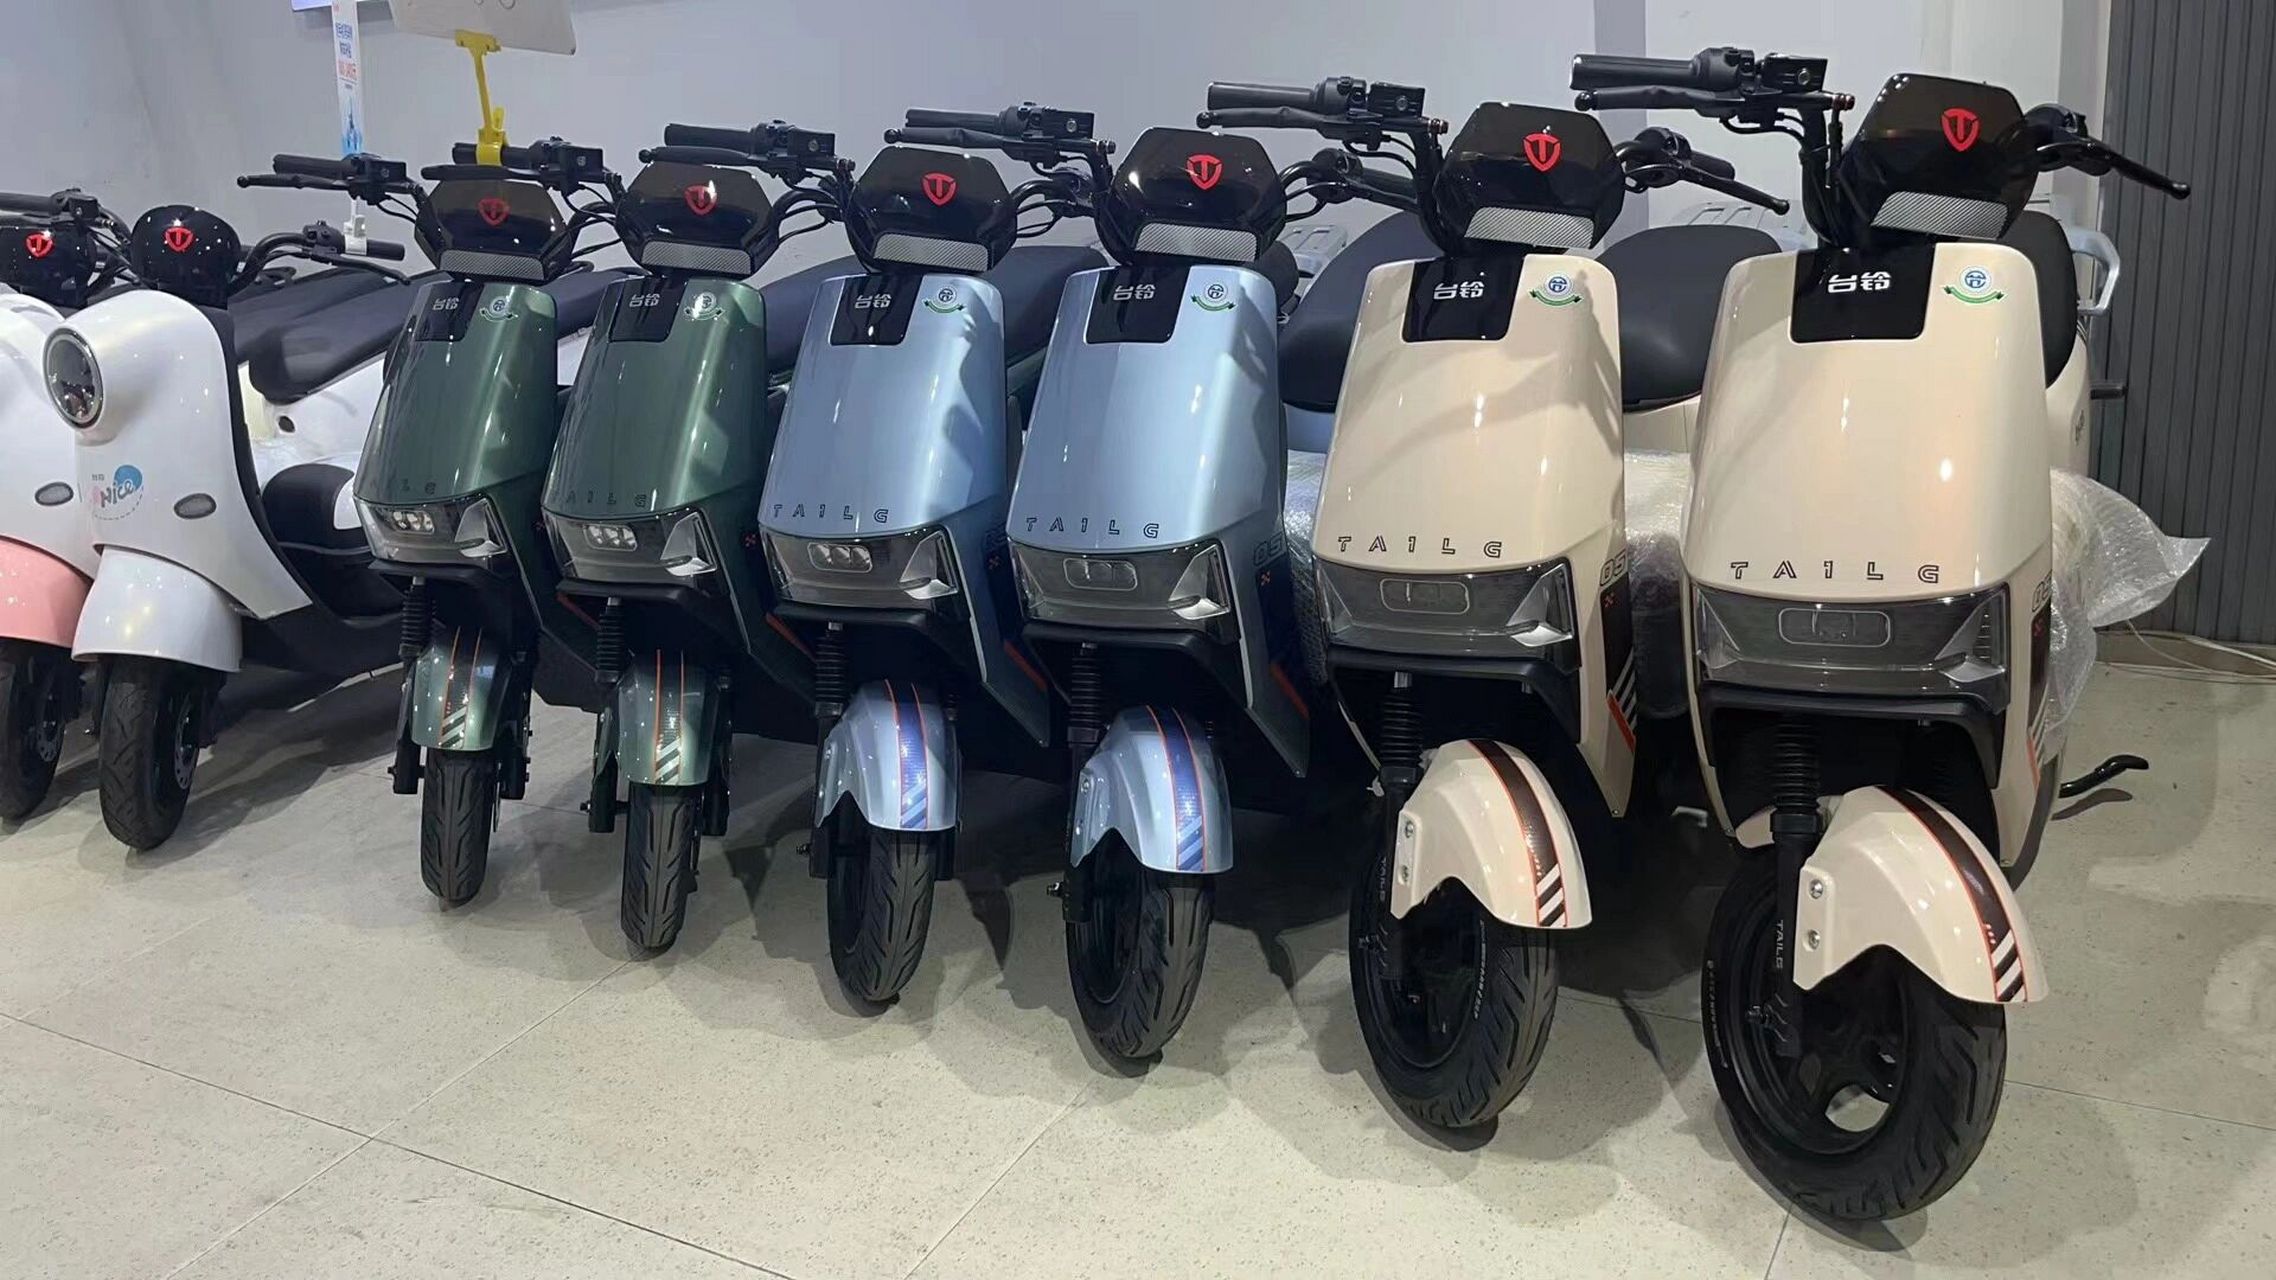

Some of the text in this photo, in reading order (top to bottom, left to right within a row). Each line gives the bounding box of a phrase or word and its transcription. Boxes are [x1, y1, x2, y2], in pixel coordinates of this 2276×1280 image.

[1113, 284, 1155, 300] 台铃
[1433, 281, 1485, 300] 台铃
[1828, 271, 1891, 293] 台铃
[629, 293, 660, 307] 台铃
[855, 293, 891, 308] 台铃
[773, 503, 889, 524] TAILG
[1026, 517, 1160, 539] TAILG
[1338, 535, 1502, 558] TAILG
[1730, 560, 1940, 584] TAILG
[1775, 919, 1784, 969] TAILG
